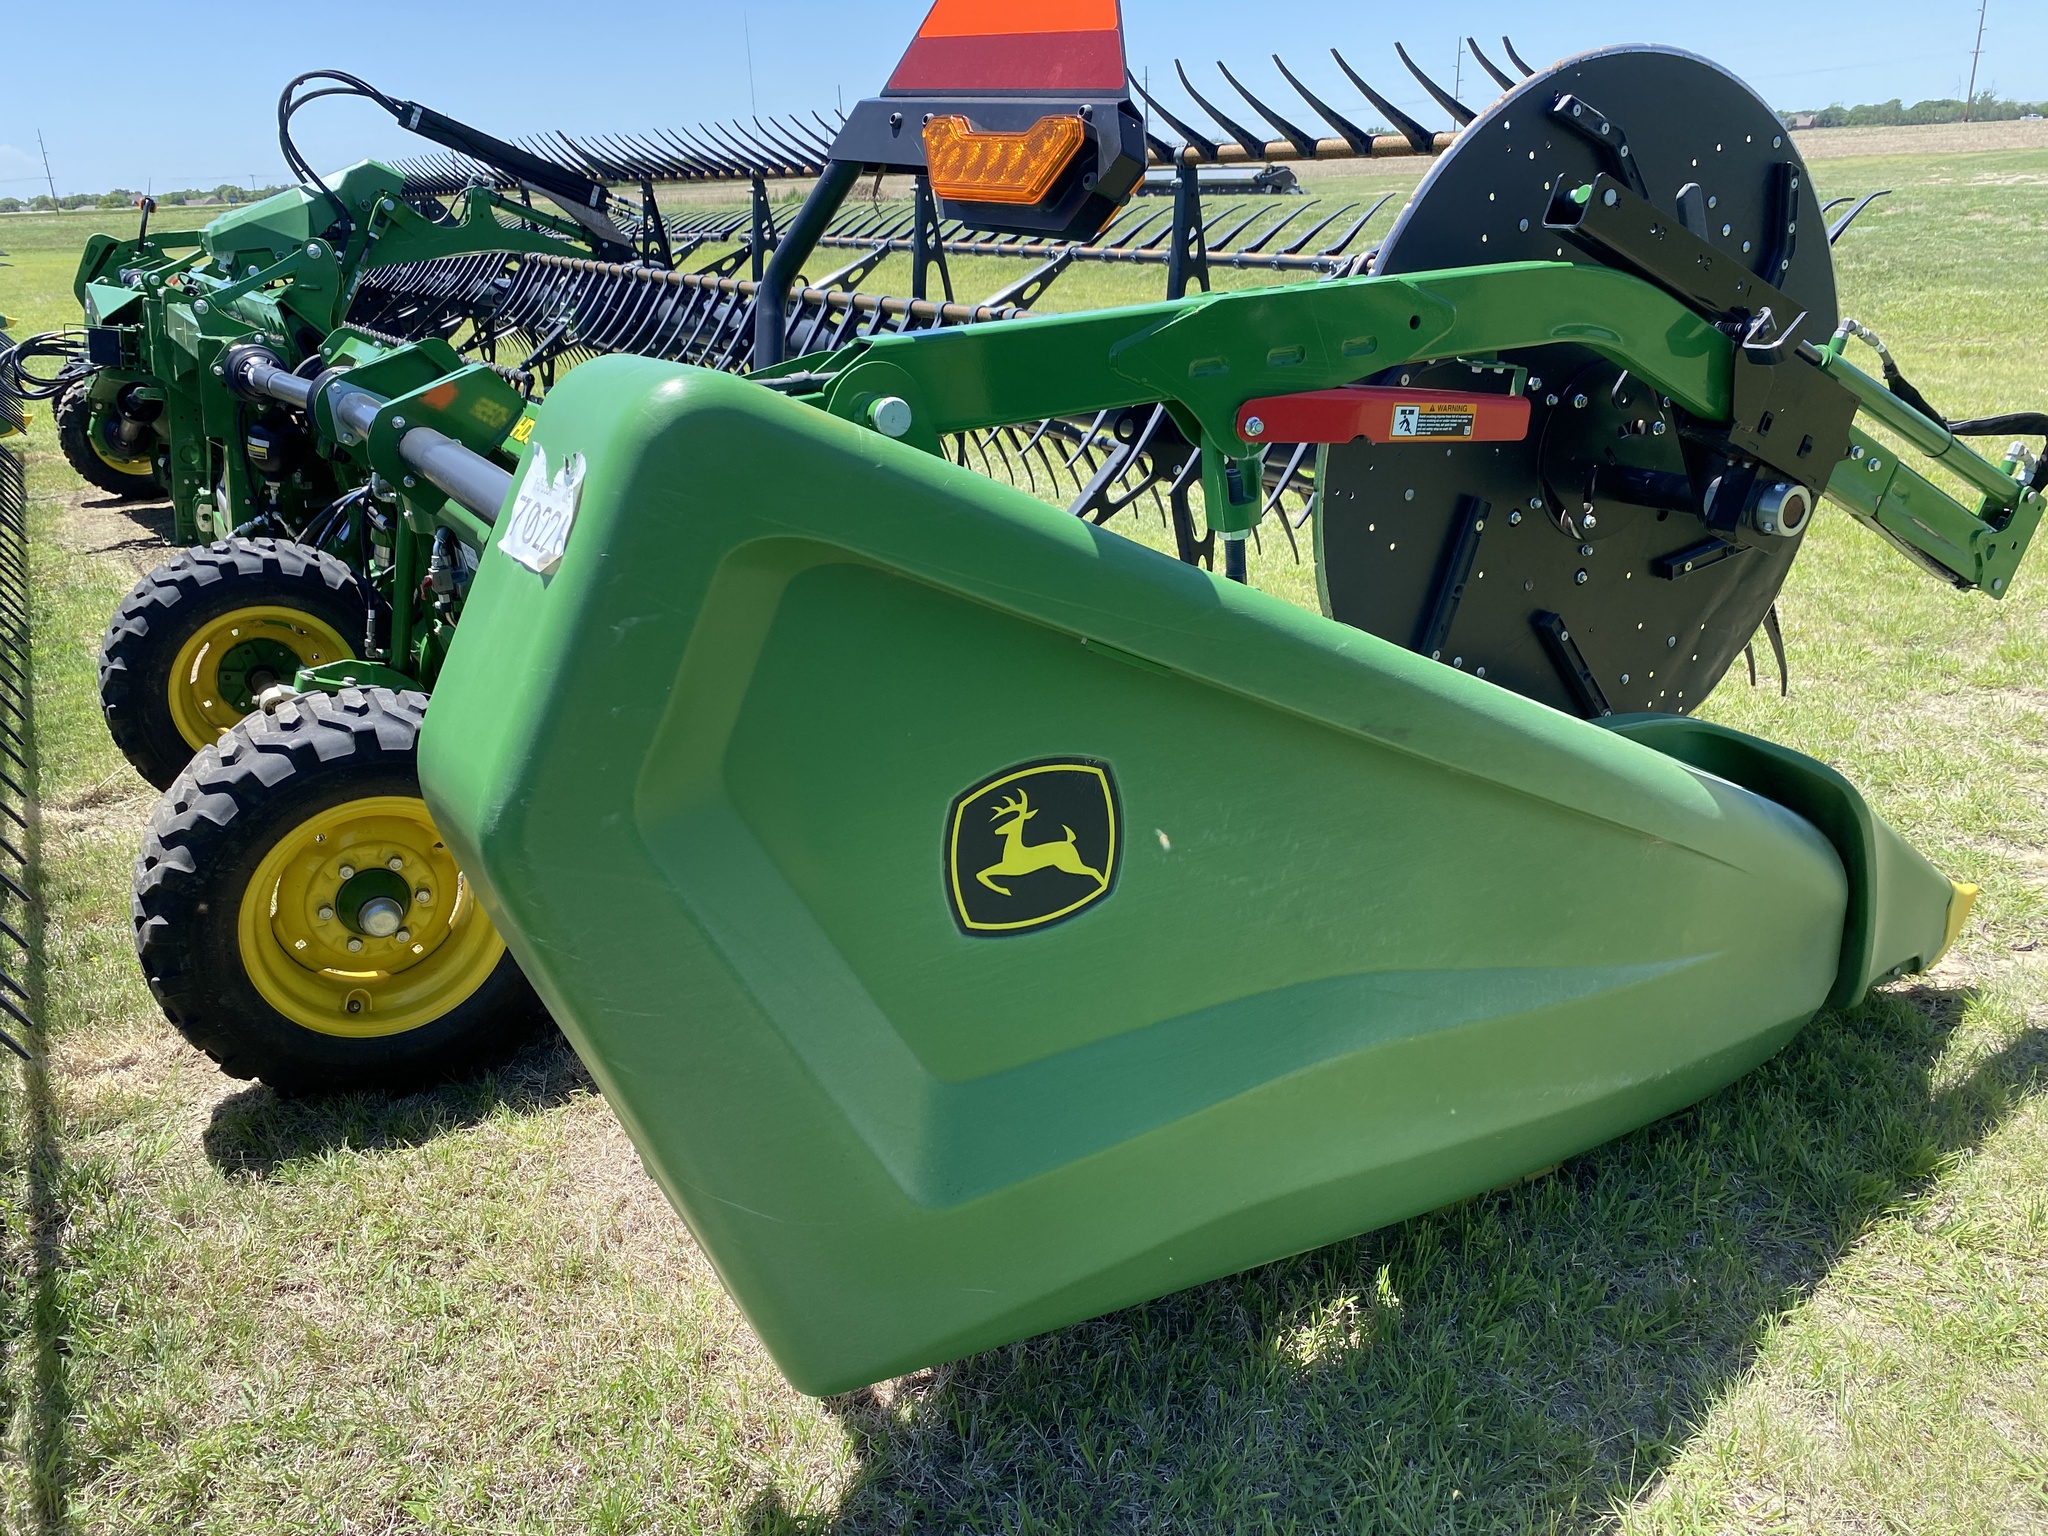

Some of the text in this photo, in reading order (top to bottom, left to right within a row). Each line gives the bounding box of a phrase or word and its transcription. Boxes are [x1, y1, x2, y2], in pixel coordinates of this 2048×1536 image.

[1703, 257, 1713, 271] 2
[1437, 404, 1468, 413] WARNING
[509, 415, 536, 446] HD
[509, 494, 569, 557] 70226
